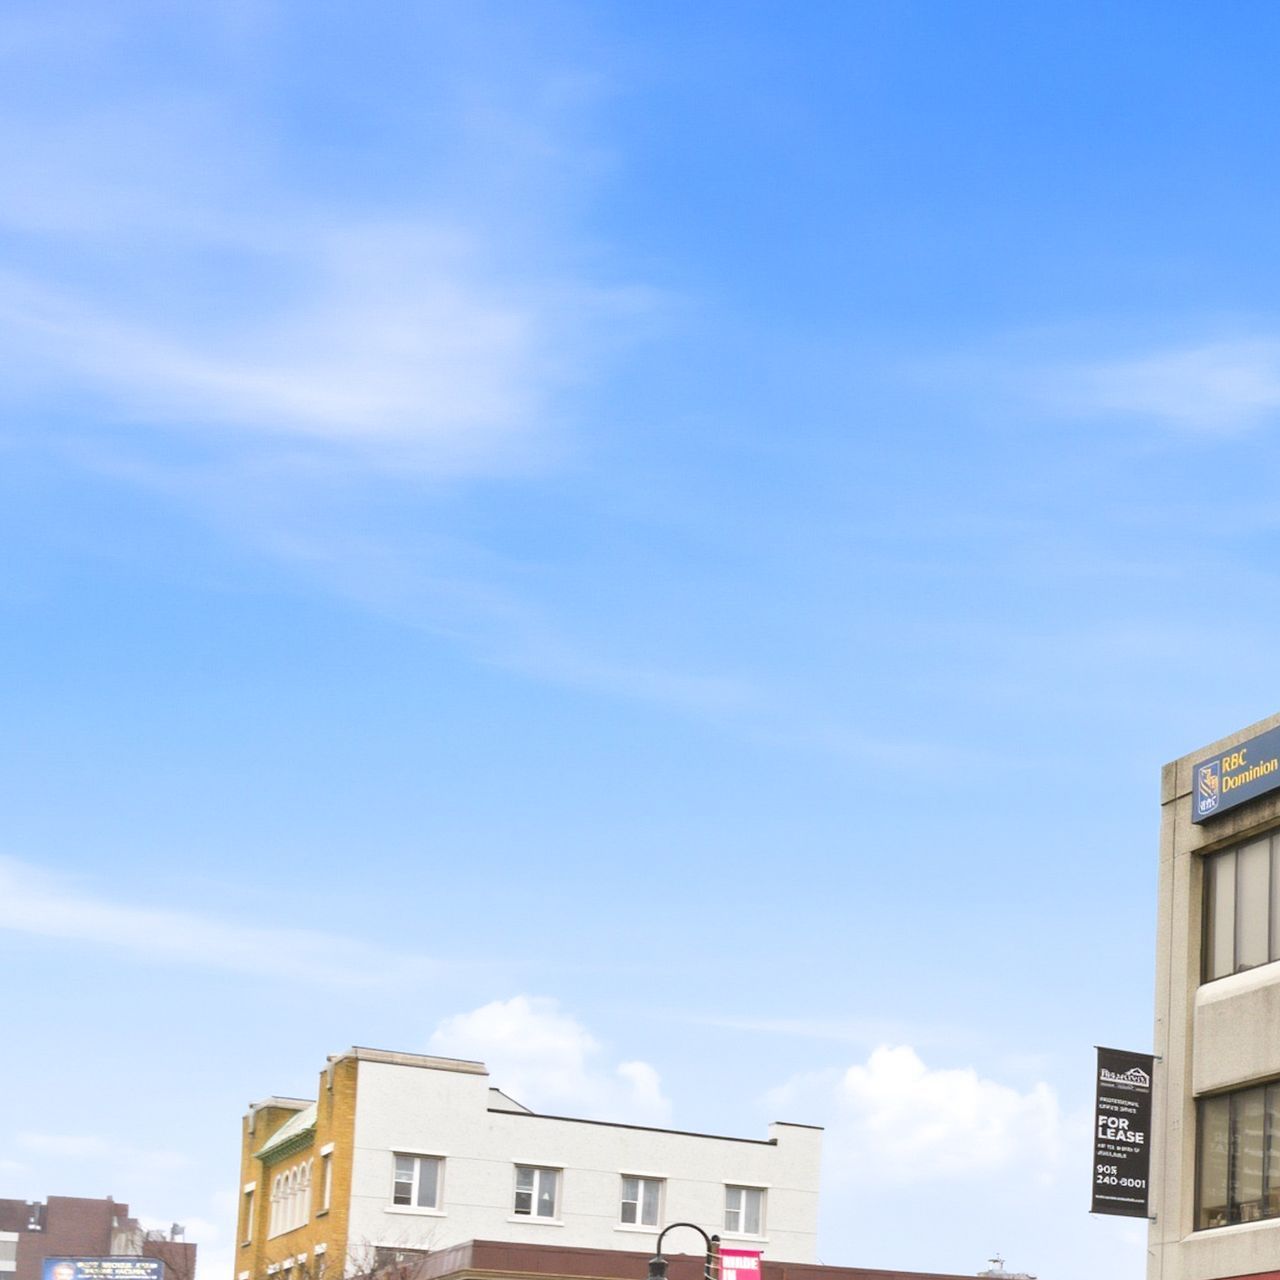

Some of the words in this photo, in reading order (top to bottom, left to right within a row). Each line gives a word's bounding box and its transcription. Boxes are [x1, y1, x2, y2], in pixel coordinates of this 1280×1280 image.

[1222, 749, 1247, 773] RBC
[1222, 758, 1279, 793] Dominion
[1098, 1115, 1129, 1130] FOR
[1098, 1127, 1144, 1144] LEASE
